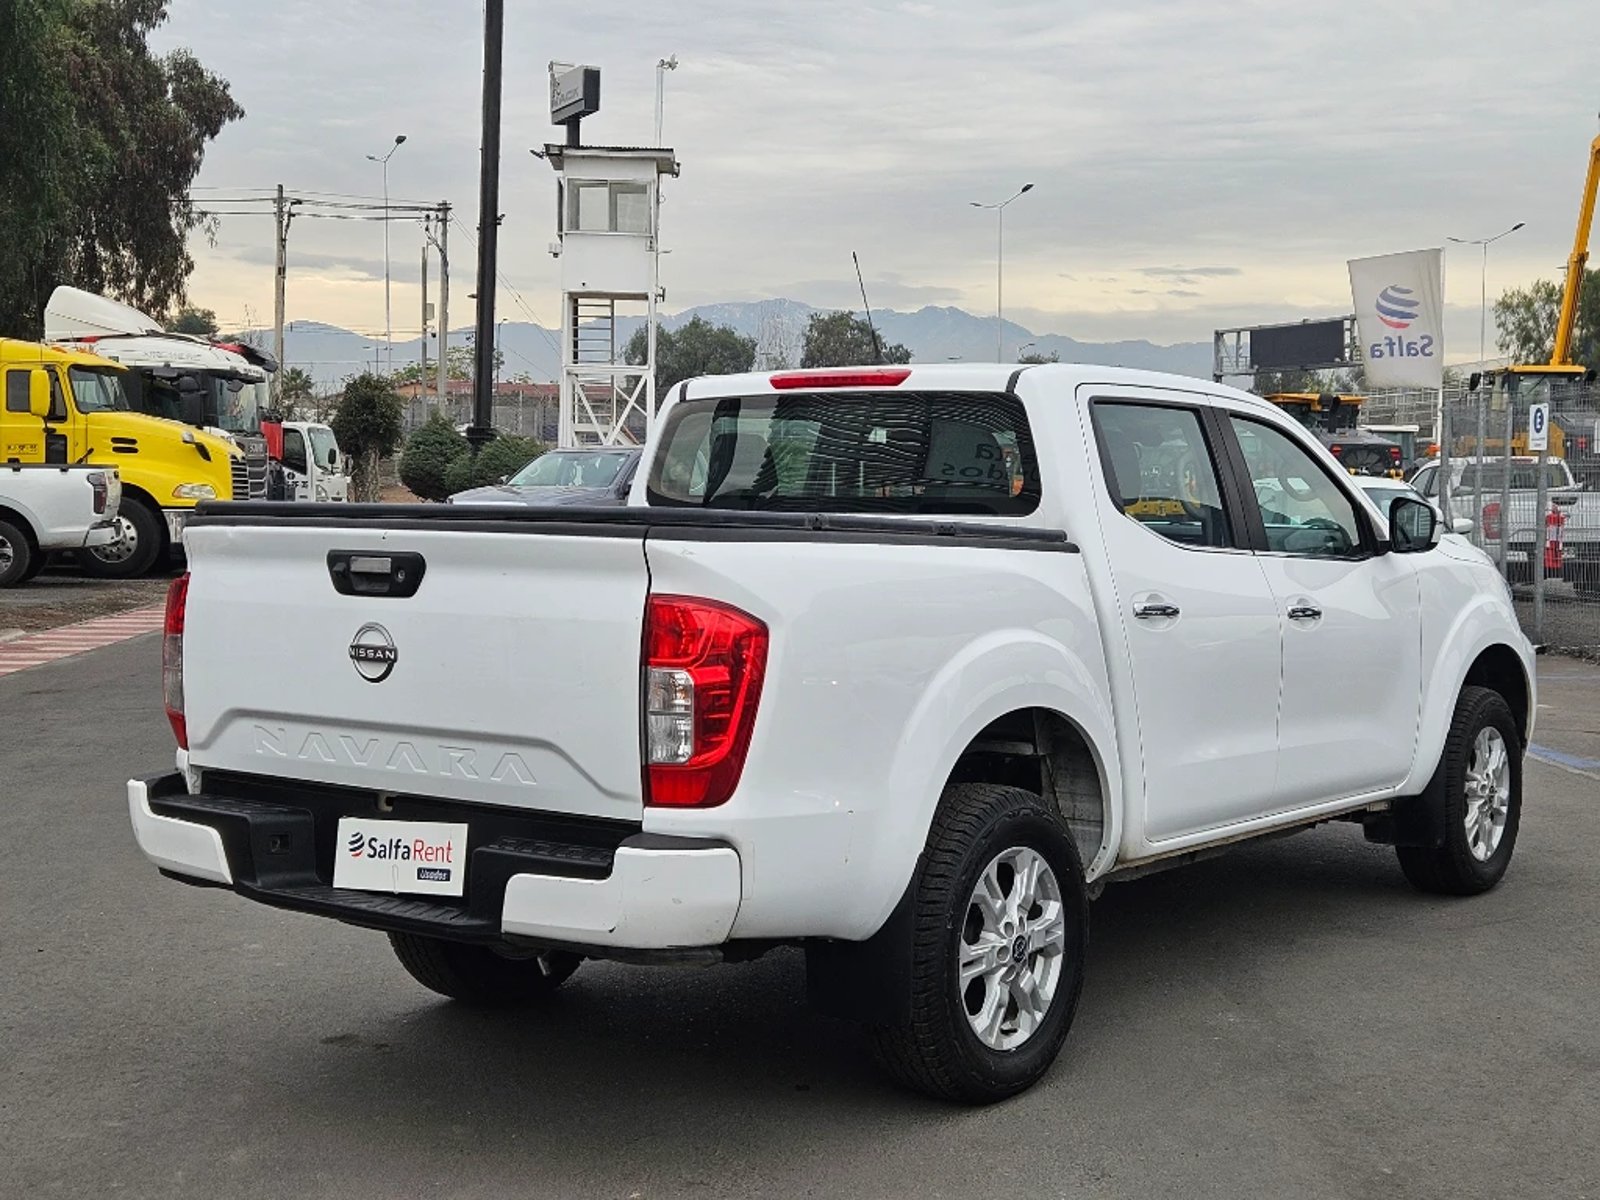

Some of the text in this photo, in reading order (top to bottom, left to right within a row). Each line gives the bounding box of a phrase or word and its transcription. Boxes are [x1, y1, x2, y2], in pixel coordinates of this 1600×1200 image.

[349, 647, 395, 660] NISSAN
[254, 724, 536, 785] NAVARA
[367, 837, 452, 863] SalfaRent
[420, 869, 448, 881] Usados
